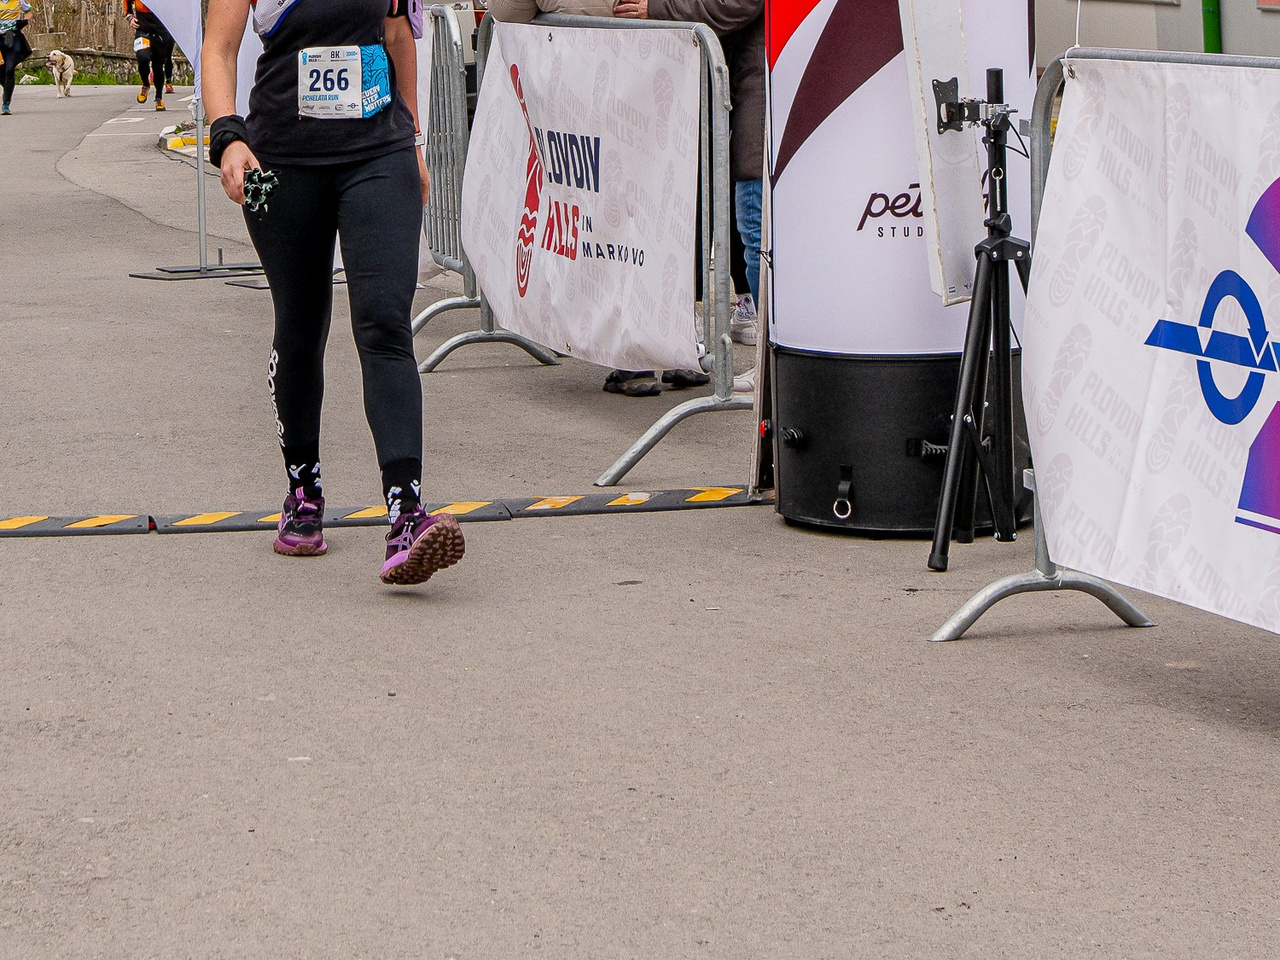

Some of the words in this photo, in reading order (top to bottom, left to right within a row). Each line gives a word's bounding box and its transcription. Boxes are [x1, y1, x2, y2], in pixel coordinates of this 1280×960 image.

[308, 68, 350, 93] 266
[534, 126, 600, 193] OVDIV
[1096, 144, 1132, 197] HILLS
[1188, 128, 1243, 199] PLOVDIV
[1184, 163, 1219, 218] HILLS
[582, 214, 593, 233] IN
[582, 241, 645, 267] MARKOVO
[1096, 240, 1160, 311] PLOVDIV
[1083, 273, 1129, 328] HILLS
[1065, 401, 1113, 460] HILLS
[1080, 370, 1144, 444] PLOVDIV
